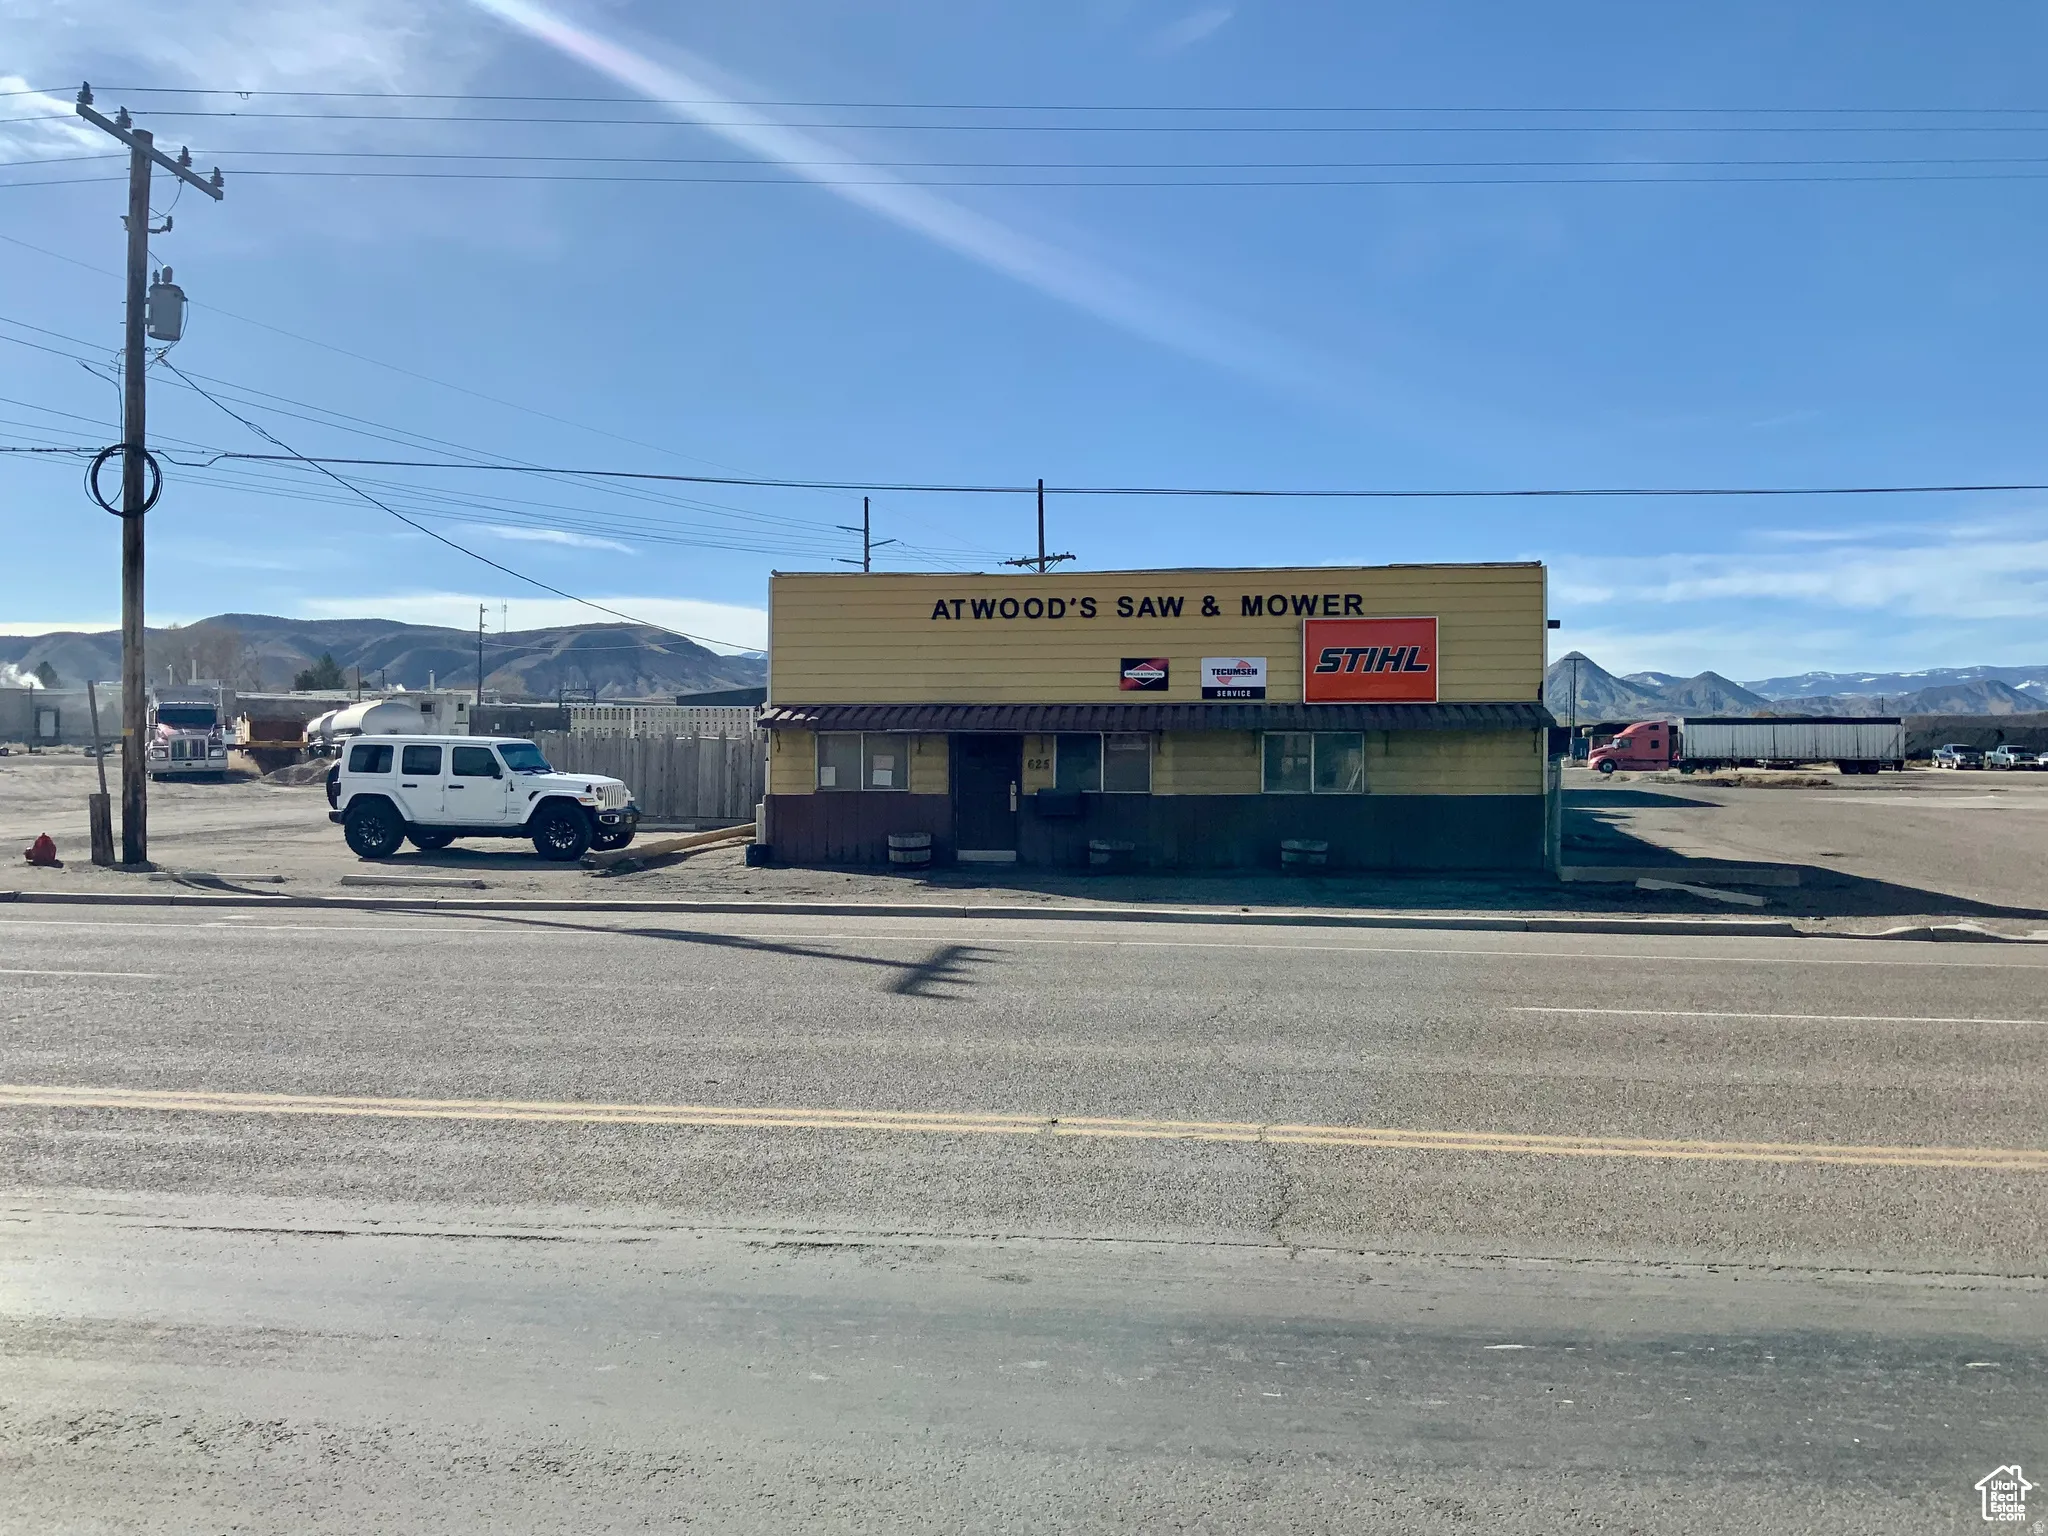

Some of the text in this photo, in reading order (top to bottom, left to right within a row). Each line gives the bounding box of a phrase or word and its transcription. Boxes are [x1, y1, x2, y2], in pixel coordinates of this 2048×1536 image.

[931, 594, 1364, 620] ATWOOD'S SAW & MOWER
[1313, 646, 1430, 674] STIHL
[1211, 668, 1258, 676] TECUMSEH
[1027, 759, 1050, 770] 625
